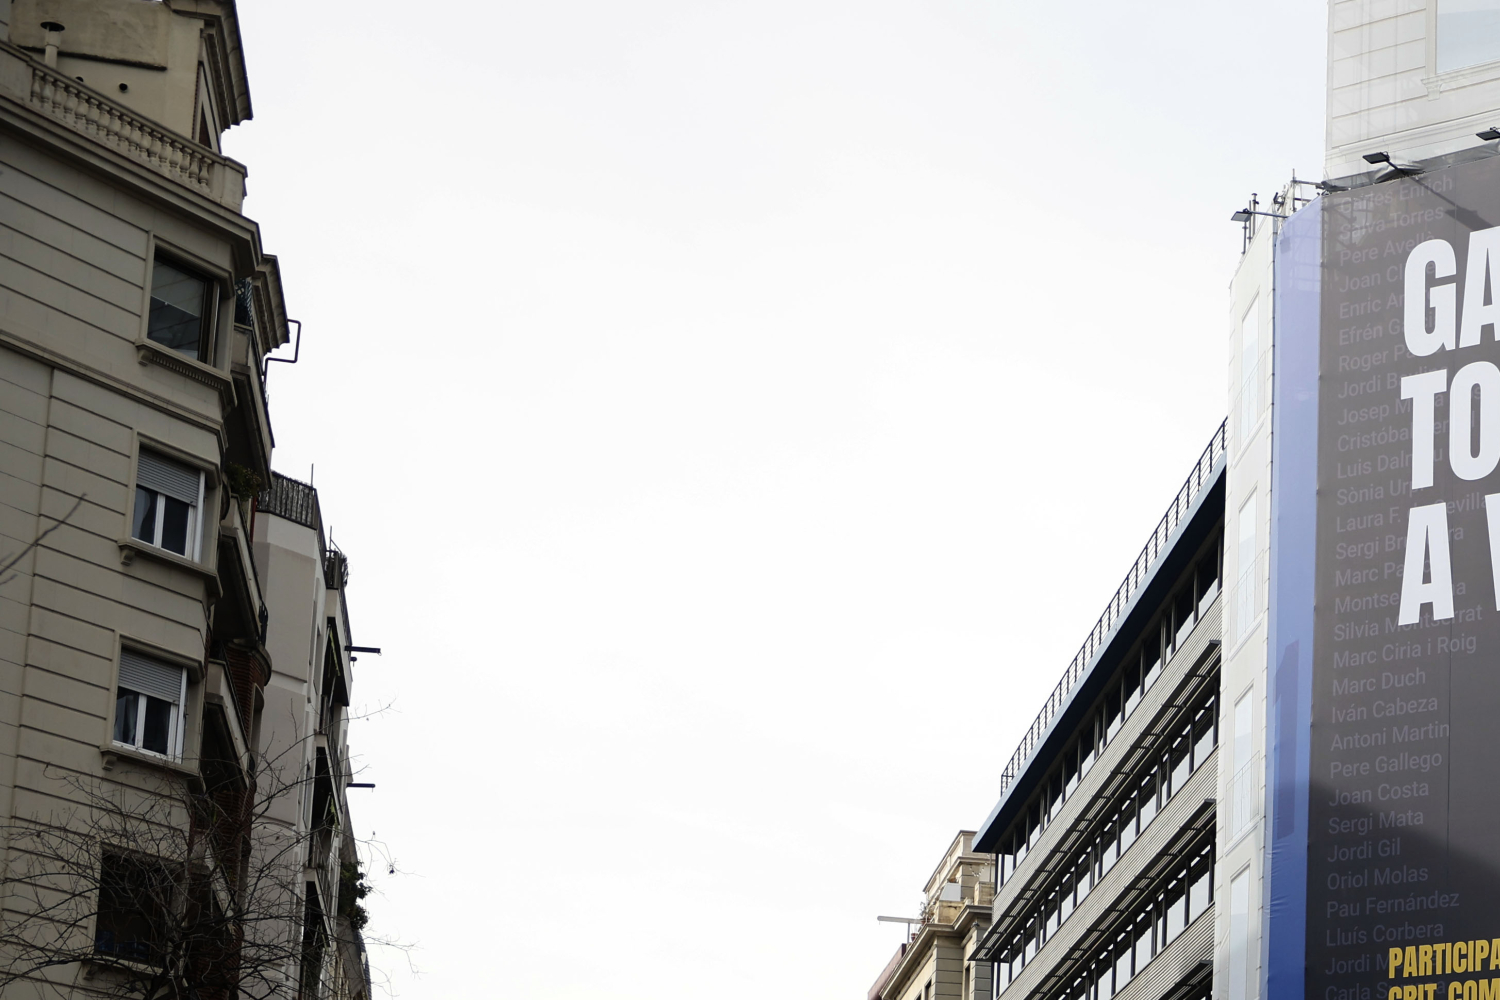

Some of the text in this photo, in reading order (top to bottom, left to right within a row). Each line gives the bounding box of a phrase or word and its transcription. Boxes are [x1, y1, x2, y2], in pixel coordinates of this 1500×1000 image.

[1398, 502, 1454, 626] A
[1334, 633, 1476, 668] Marc Ciria i Roig
[1333, 667, 1425, 696] Marc Duch
[1332, 697, 1437, 723] Iván Cabeza
[1330, 752, 1441, 778] Pere Gallego
[1327, 865, 1428, 889] Oriol Molas
[1327, 890, 1459, 918] Pau Fernández
